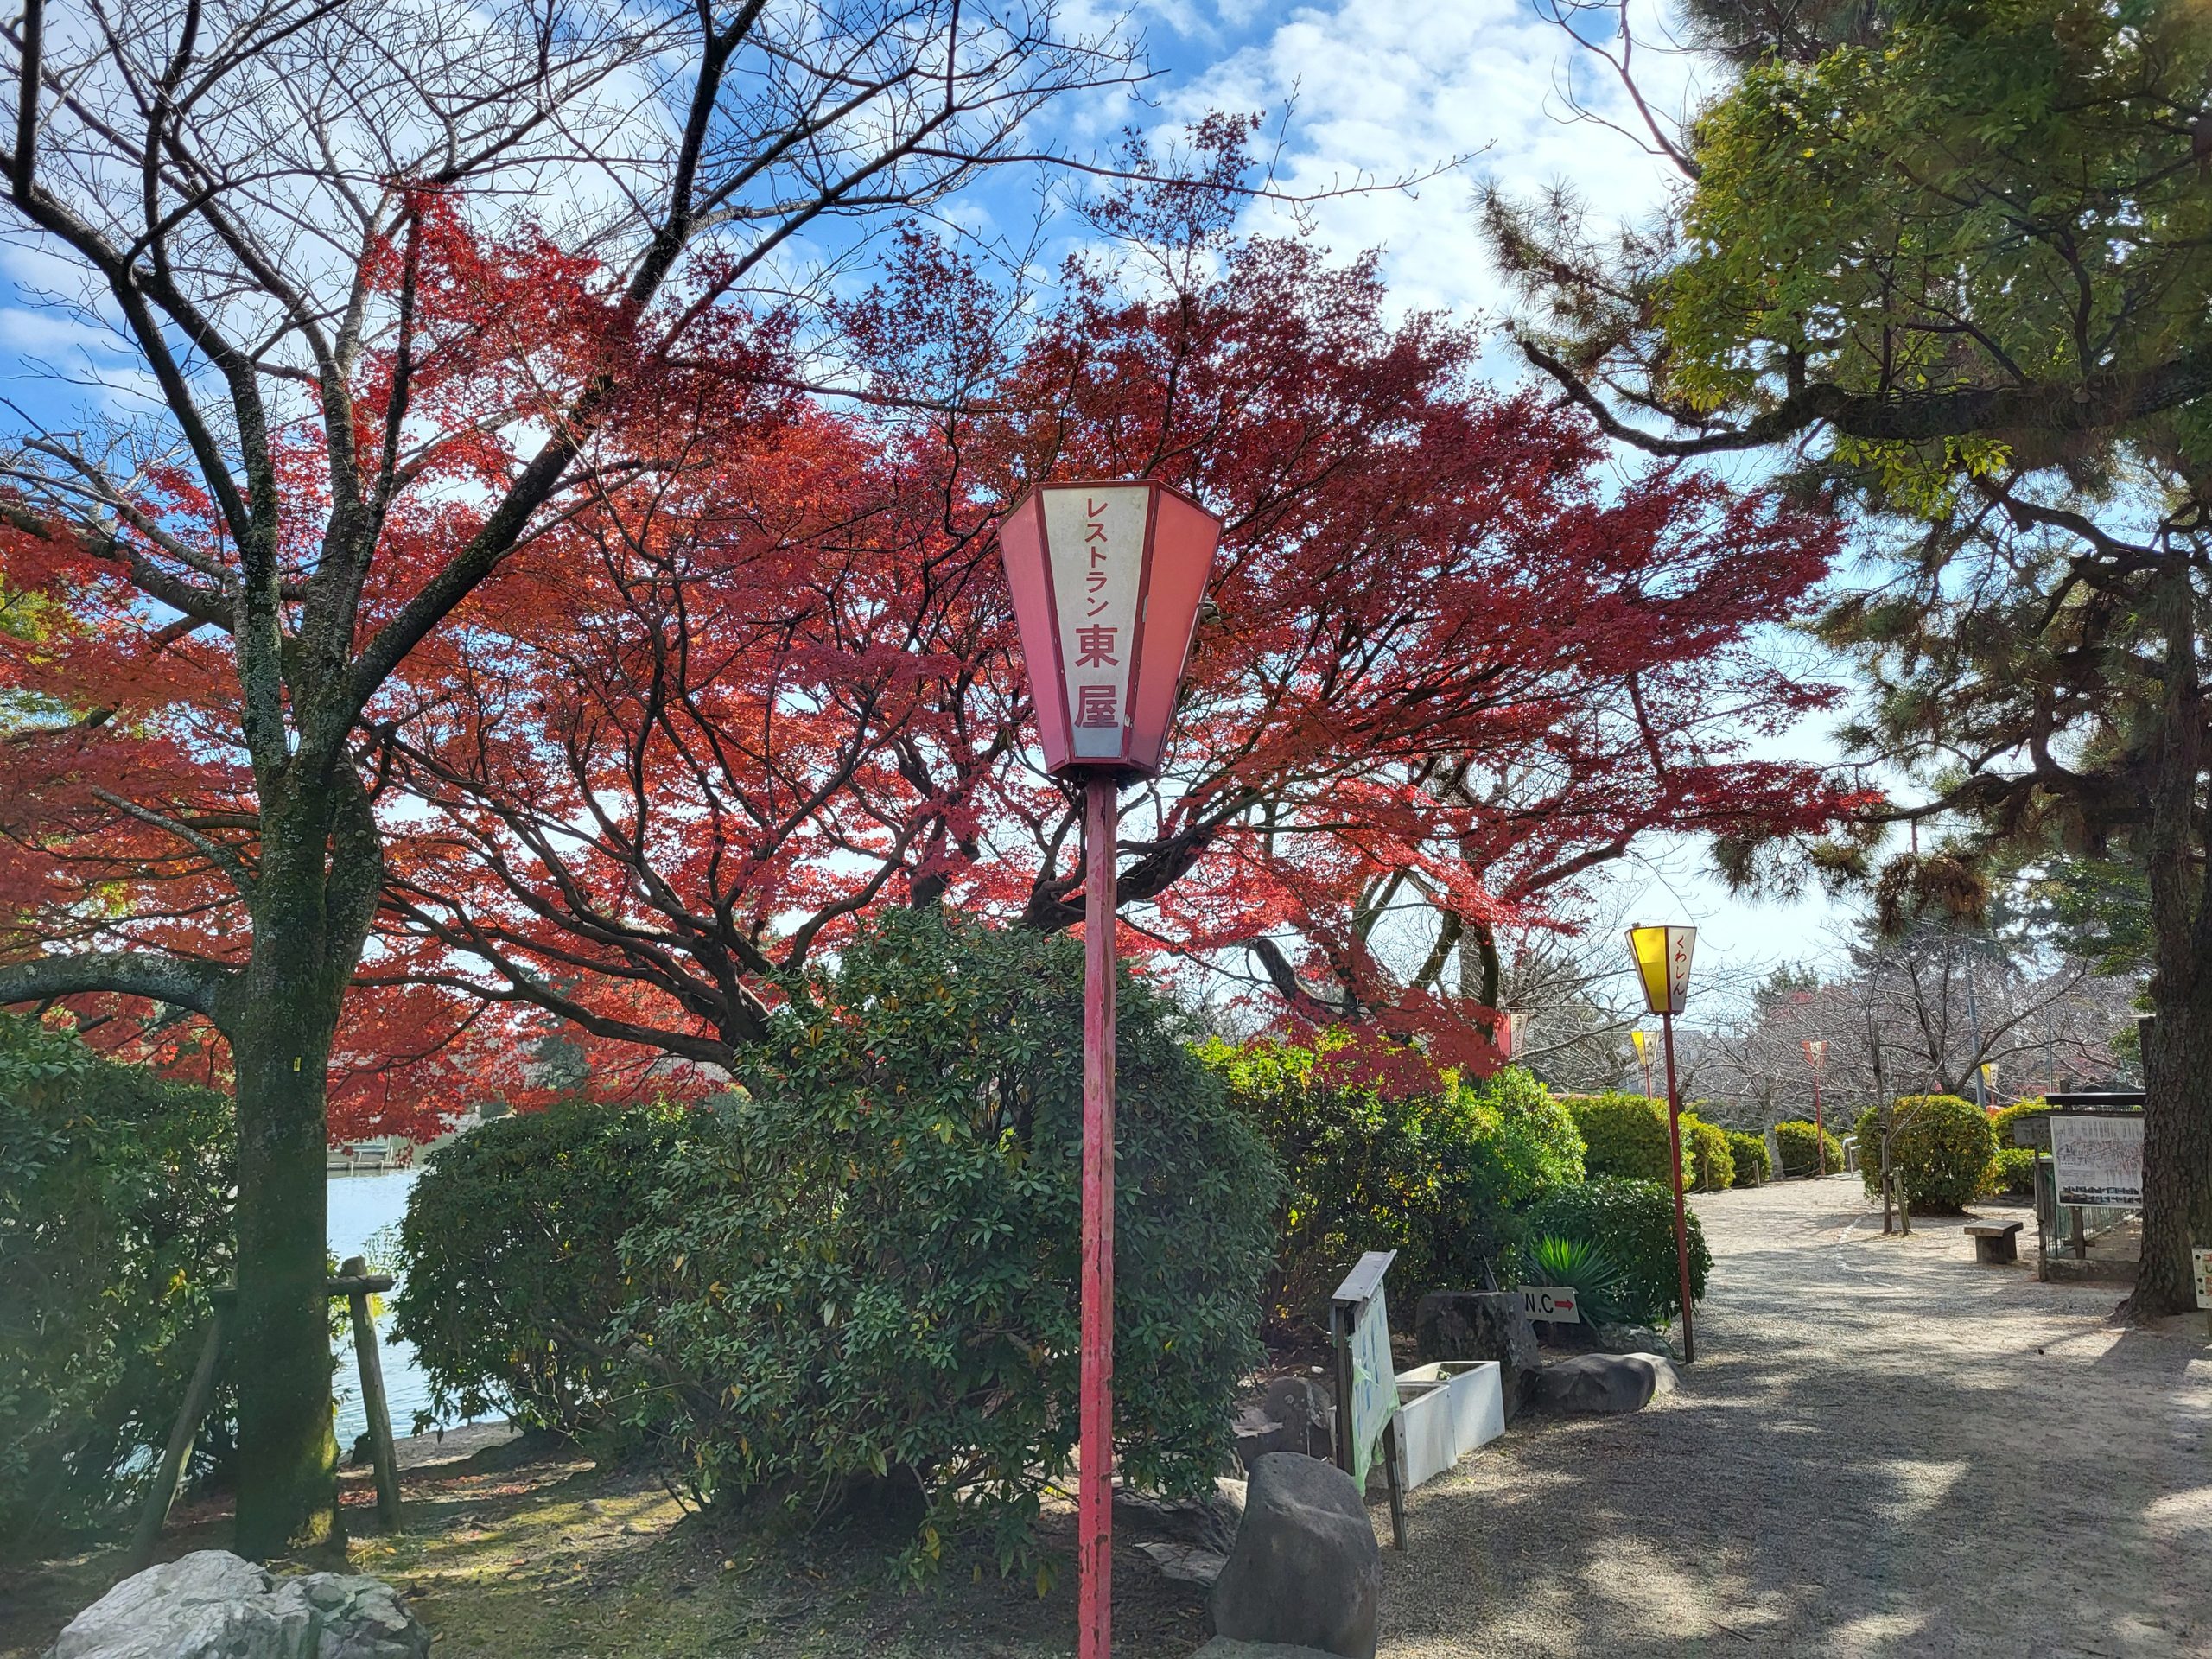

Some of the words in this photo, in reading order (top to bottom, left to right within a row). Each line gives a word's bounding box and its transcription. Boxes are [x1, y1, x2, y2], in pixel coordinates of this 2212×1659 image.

[1074, 498, 1120, 728] レストラン東屋
[1673, 935, 1687, 995] くわしん
